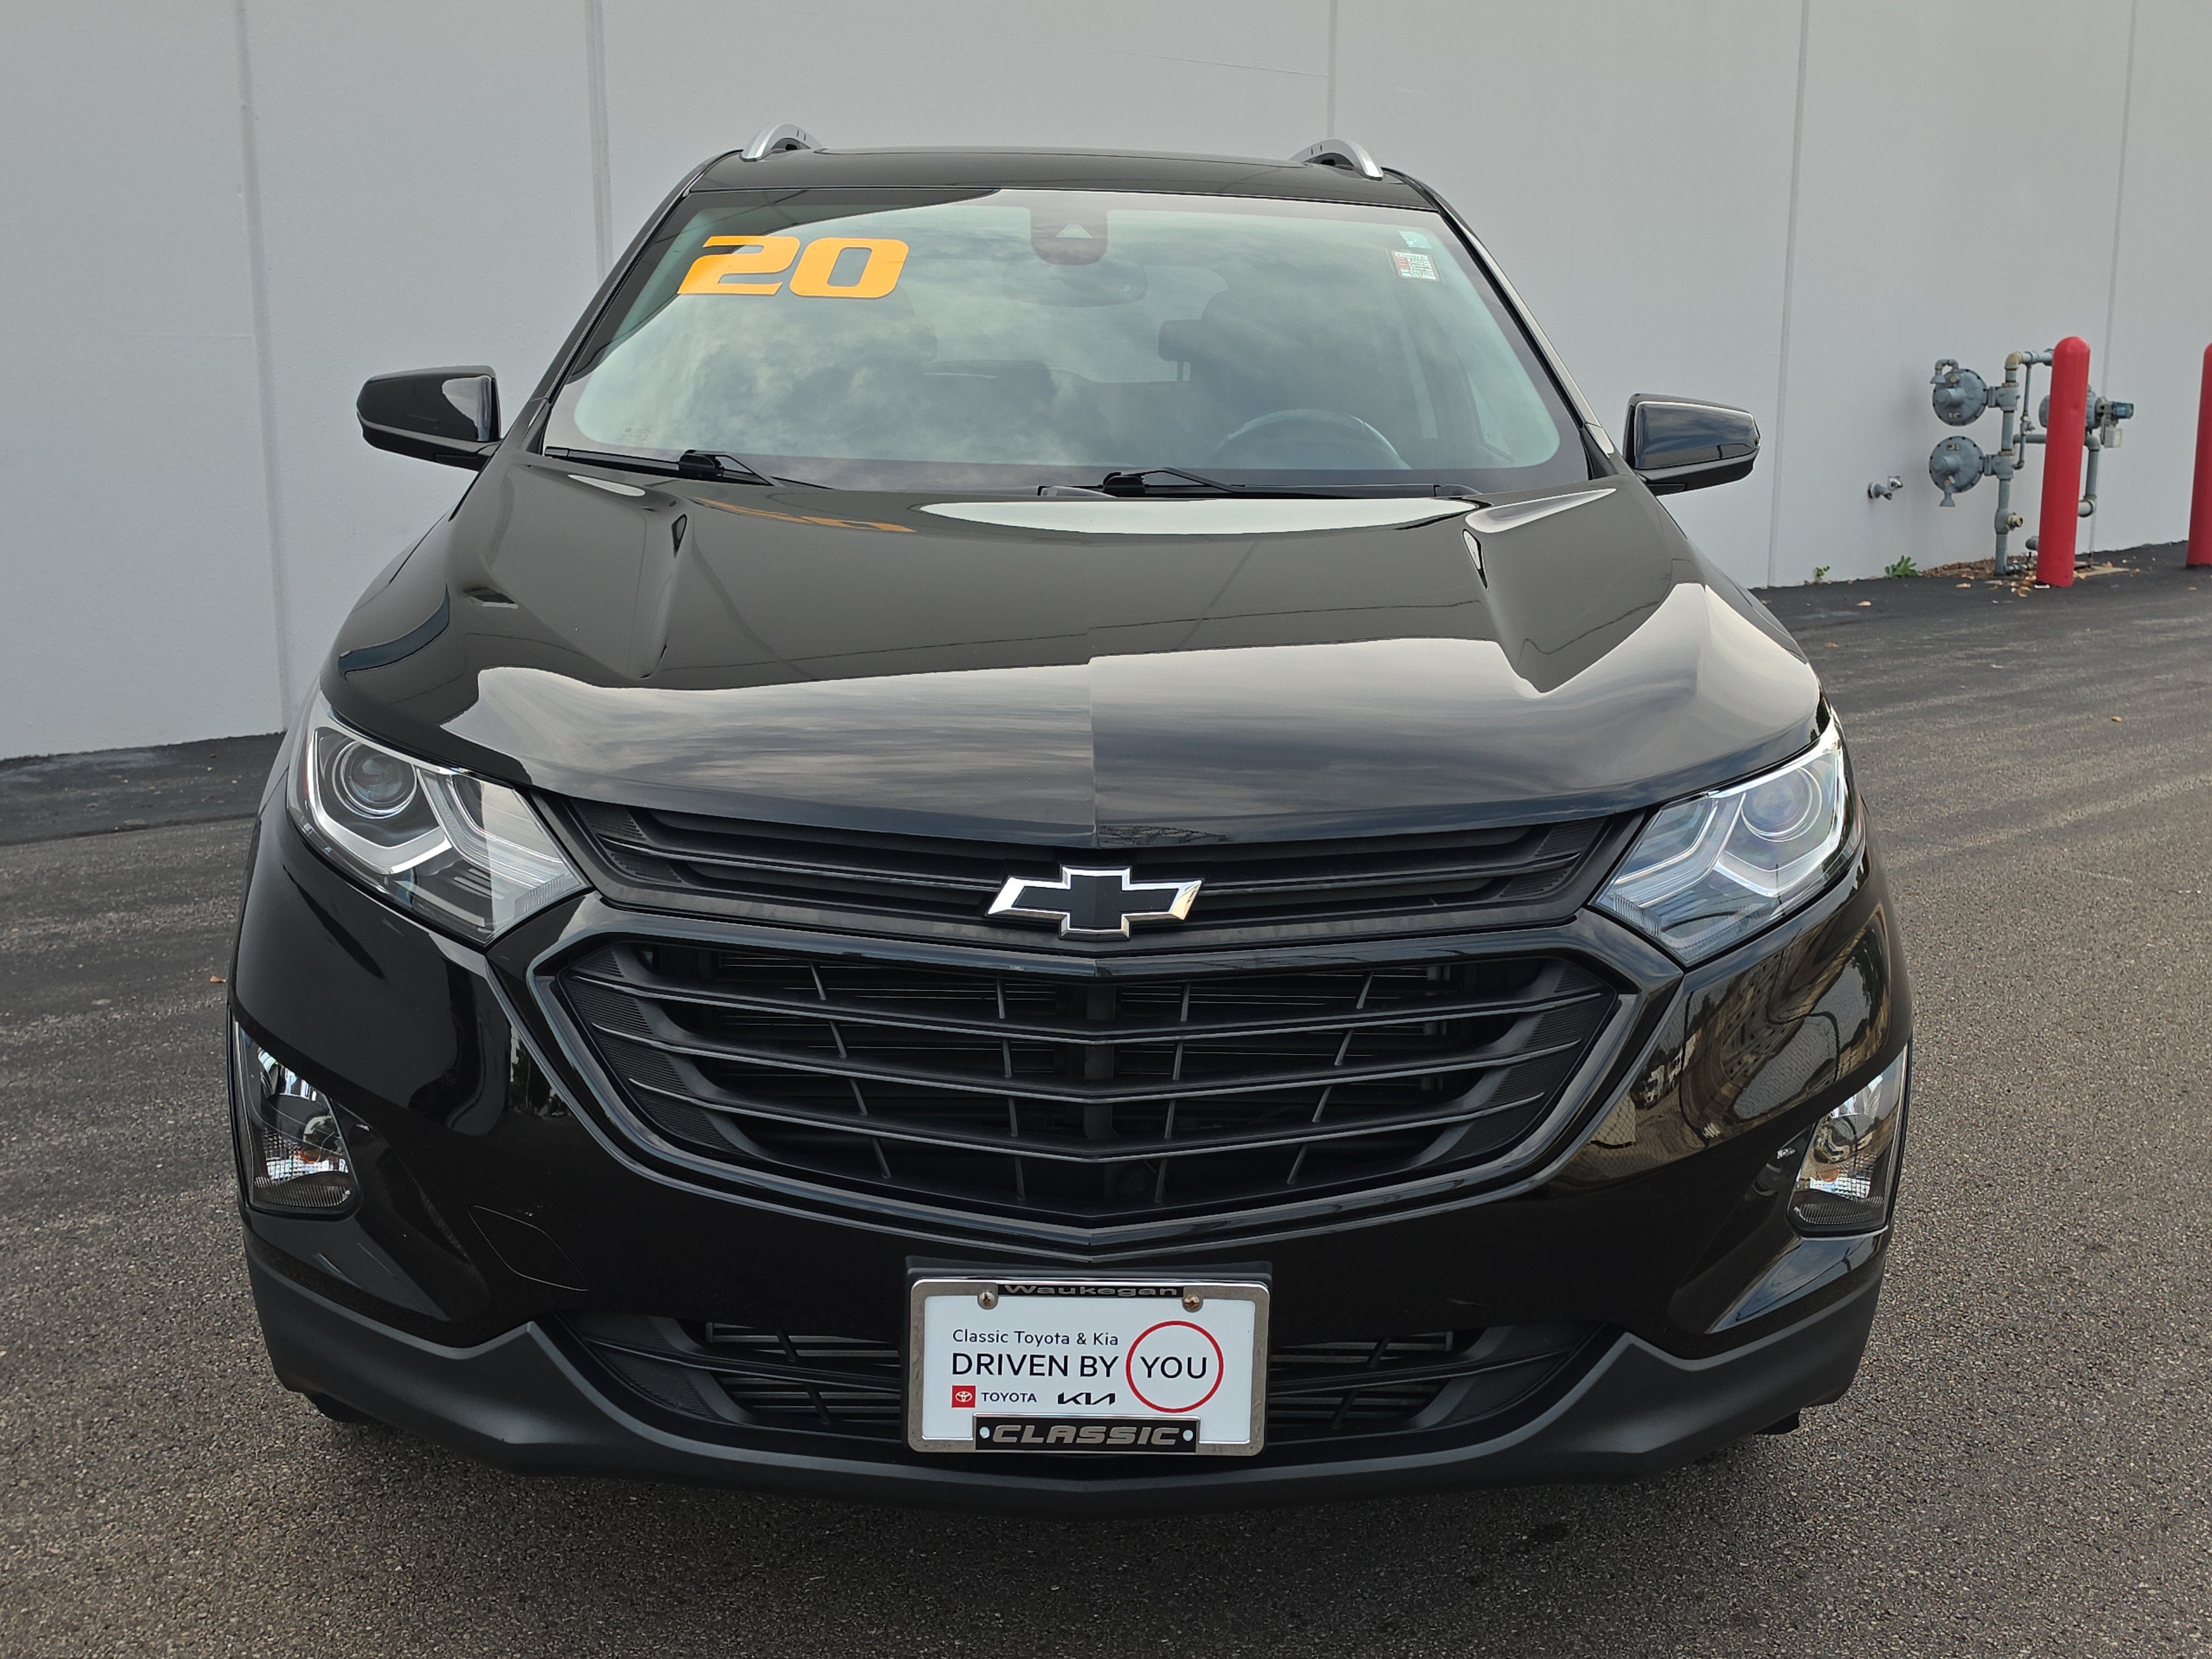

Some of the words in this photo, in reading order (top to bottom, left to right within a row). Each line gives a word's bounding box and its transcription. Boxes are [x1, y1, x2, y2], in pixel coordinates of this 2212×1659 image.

[677, 235, 909, 298] 20
[1005, 1285, 1177, 1296] Waukegan
[953, 1329, 1008, 1343] Classic
[1014, 1331, 1070, 1347] Toyota
[1076, 1332, 1086, 1345] &
[1093, 1332, 1118, 1346] Kia
[952, 1353, 1069, 1377] DRIVEN
[1080, 1355, 1118, 1378] BY
[1140, 1356, 1207, 1379] YOU
[981, 1392, 1037, 1403] TOYOTA
[992, 1425, 1179, 1445] CLASSIC
